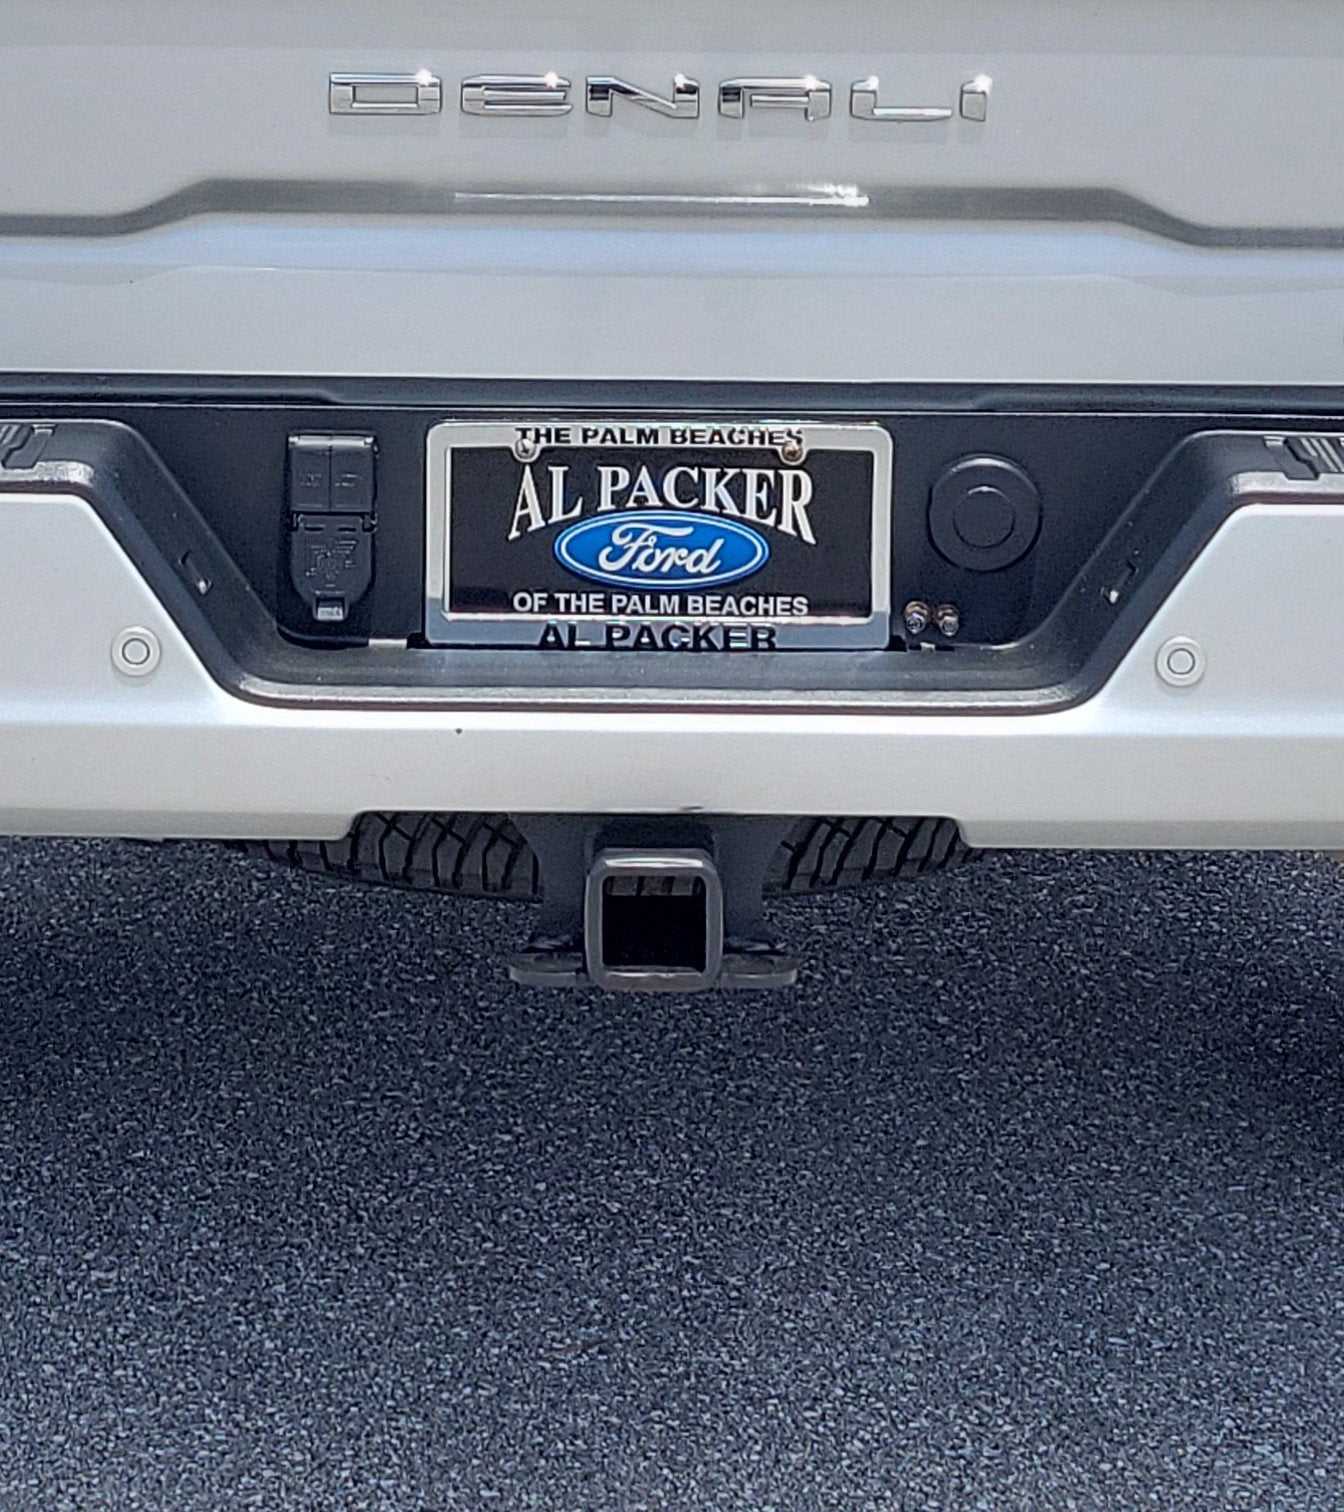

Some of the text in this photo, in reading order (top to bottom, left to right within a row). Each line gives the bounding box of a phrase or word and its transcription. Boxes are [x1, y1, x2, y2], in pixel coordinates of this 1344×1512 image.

[328, 71, 992, 123] DENALI
[515, 427, 803, 445] THE PALM BEACHES
[508, 463, 818, 545] AL PACKER
[598, 523, 722, 575] Ford
[513, 592, 809, 616] OF THE PALM BEACHES
[537, 622, 778, 651] AL PACKER
